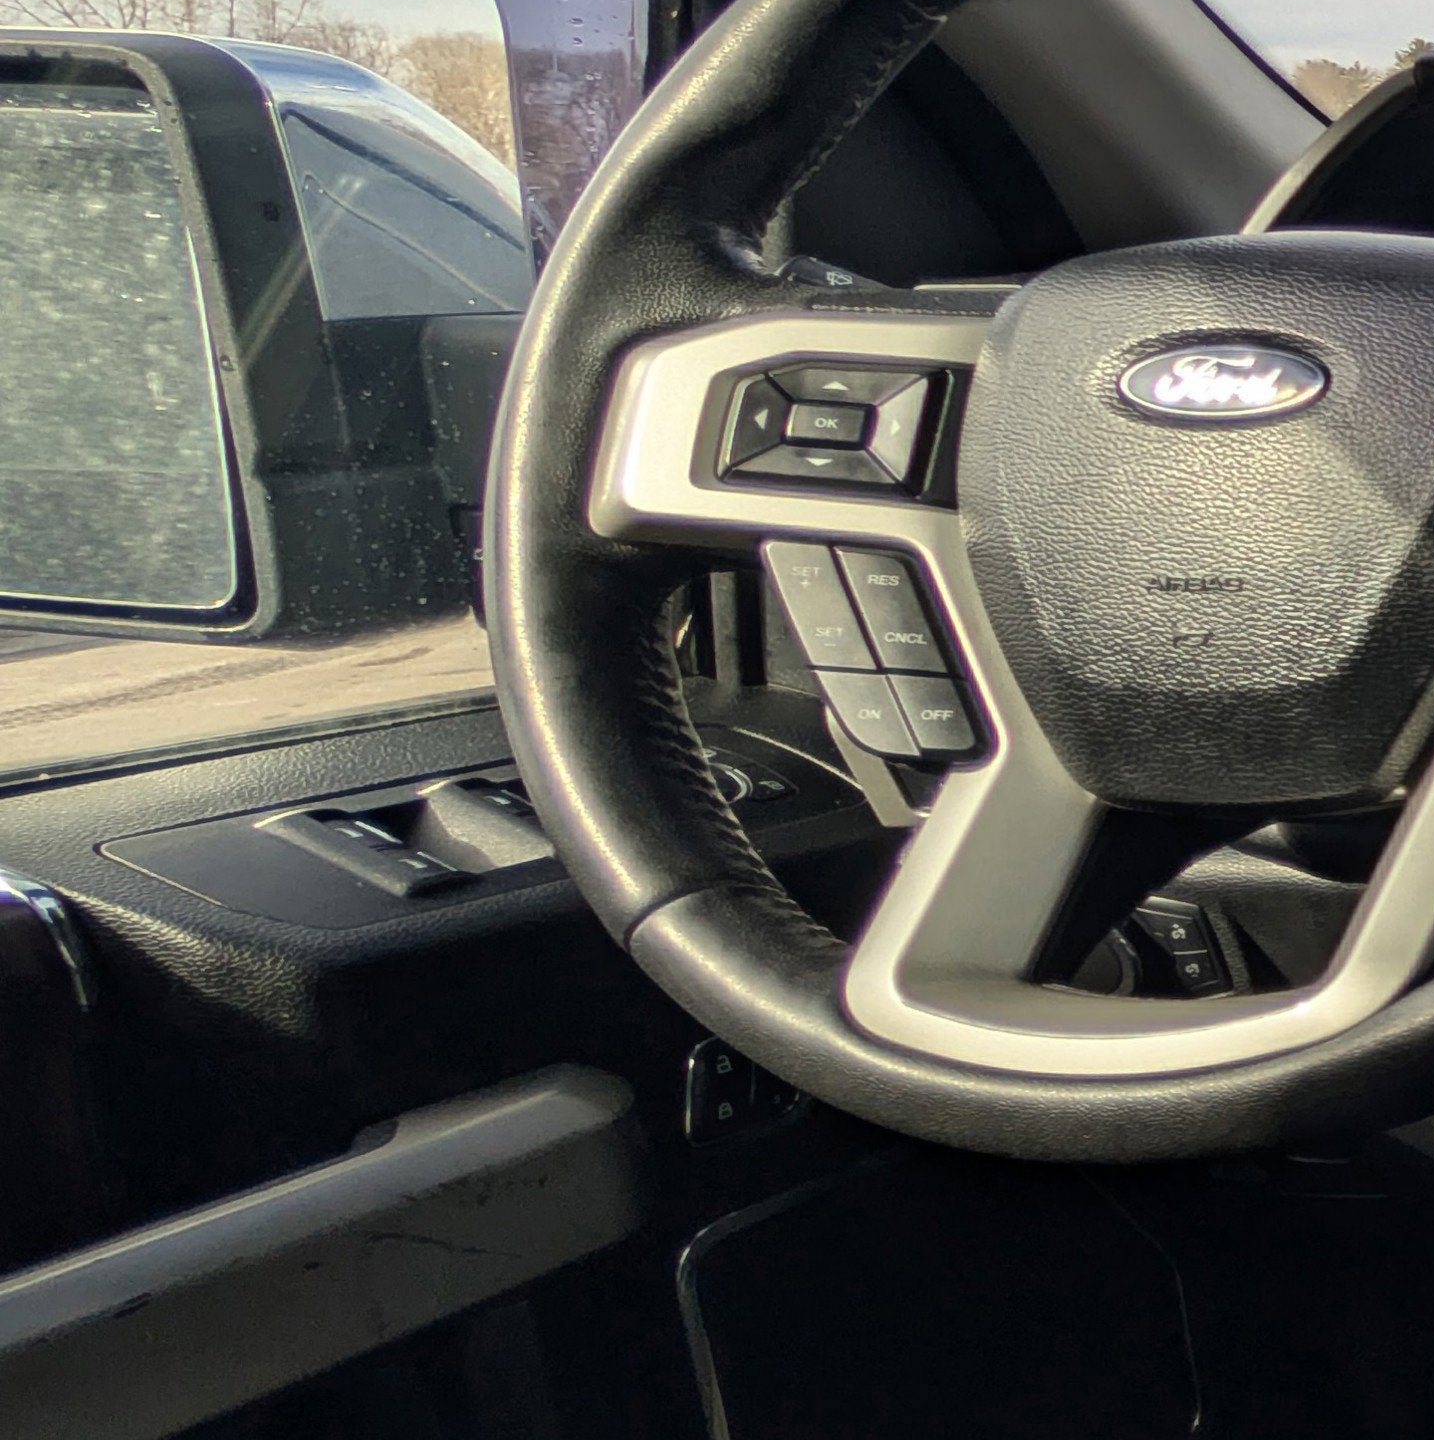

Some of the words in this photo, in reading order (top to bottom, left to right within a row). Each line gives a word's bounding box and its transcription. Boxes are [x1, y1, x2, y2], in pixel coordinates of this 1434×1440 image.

[1155, 355, 1283, 406] Ford
[814, 417, 839, 430] OK
[867, 574, 900, 587] RES
[884, 632, 927, 645] CNCL
[858, 708, 881, 720] ON
[921, 709, 954, 721] OFF
